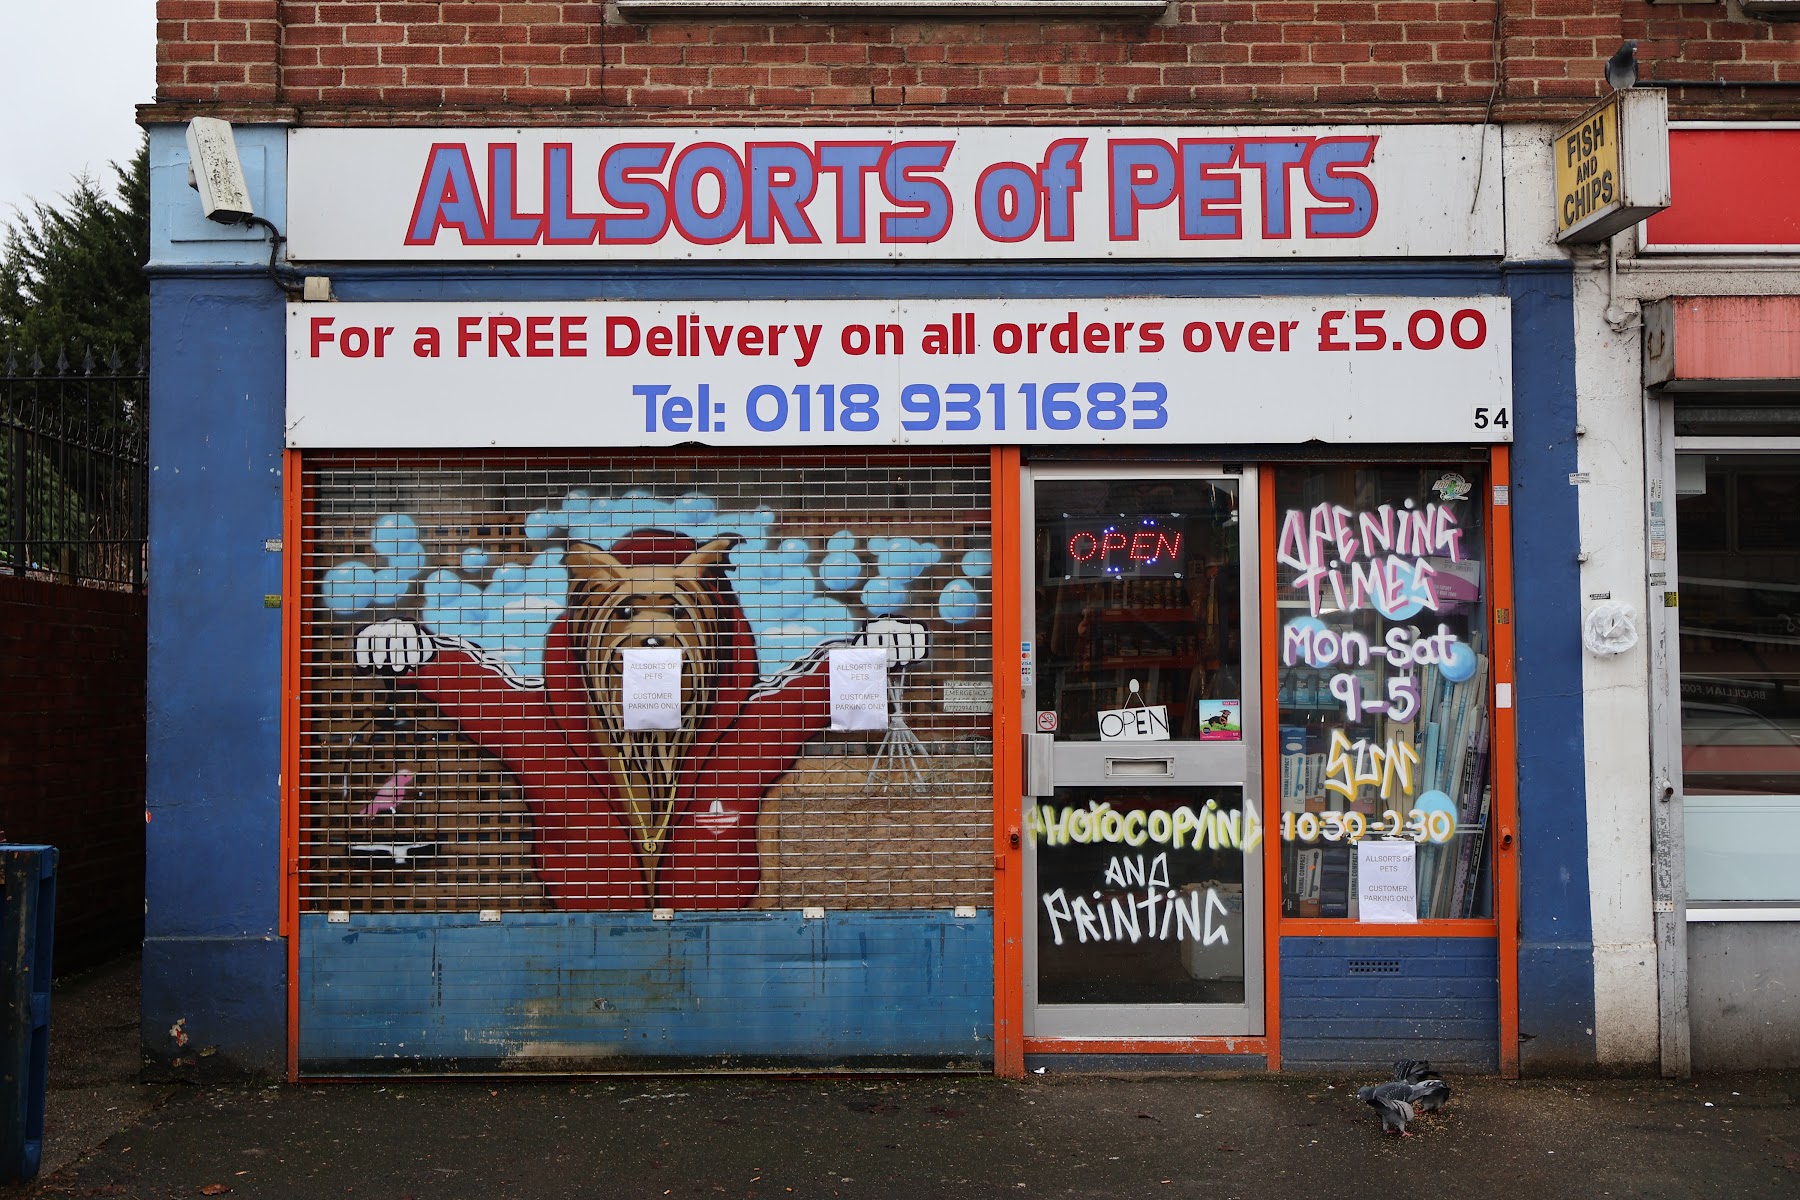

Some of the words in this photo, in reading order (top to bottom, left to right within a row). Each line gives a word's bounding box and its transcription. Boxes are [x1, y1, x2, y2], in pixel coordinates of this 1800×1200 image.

[1566, 114, 1605, 168] FISH
[1576, 156, 1598, 185] AND
[403, 140, 957, 246] ALLSORTS
[975, 137, 1089, 243] of
[1107, 135, 1380, 242] PETS
[1563, 170, 1613, 226] CHIPS
[309, 316, 395, 358] For
[413, 322, 440, 358] a
[457, 316, 588, 358] FREE
[605, 314, 823, 368] Delivery
[840, 320, 903, 356] on
[921, 312, 976, 355] all
[992, 311, 1165, 354] orders
[1182, 318, 1300, 353] over
[1317, 308, 1487, 352] £5.00
[632, 383, 726, 433] Tel:
[745, 382, 880, 432] 0118
[900, 381, 1169, 432] 9311683
[1473, 406, 1510, 429] 54
[1069, 532, 1181, 562] OPEN
[667, 662, 678, 670] OF
[836, 663, 873, 671] ALLSORTS
[644, 672, 663, 680] PETS
[850, 673, 870, 681] PETS
[633, 692, 673, 700] CUSTOMER
[839, 693, 880, 701] CUSTOMER
[945, 689, 988, 697] EMERGENCY
[628, 702, 660, 710] PARKING
[660, 702, 680, 710] ONLY
[835, 703, 867, 711] PARKING
[1100, 707, 1169, 738] OPEN
[1324, 729, 1421, 803] SUN
[1365, 855, 1401, 863] ALLSORTS
[1104, 852, 1170, 888] AND
[1379, 865, 1398, 873] PETS
